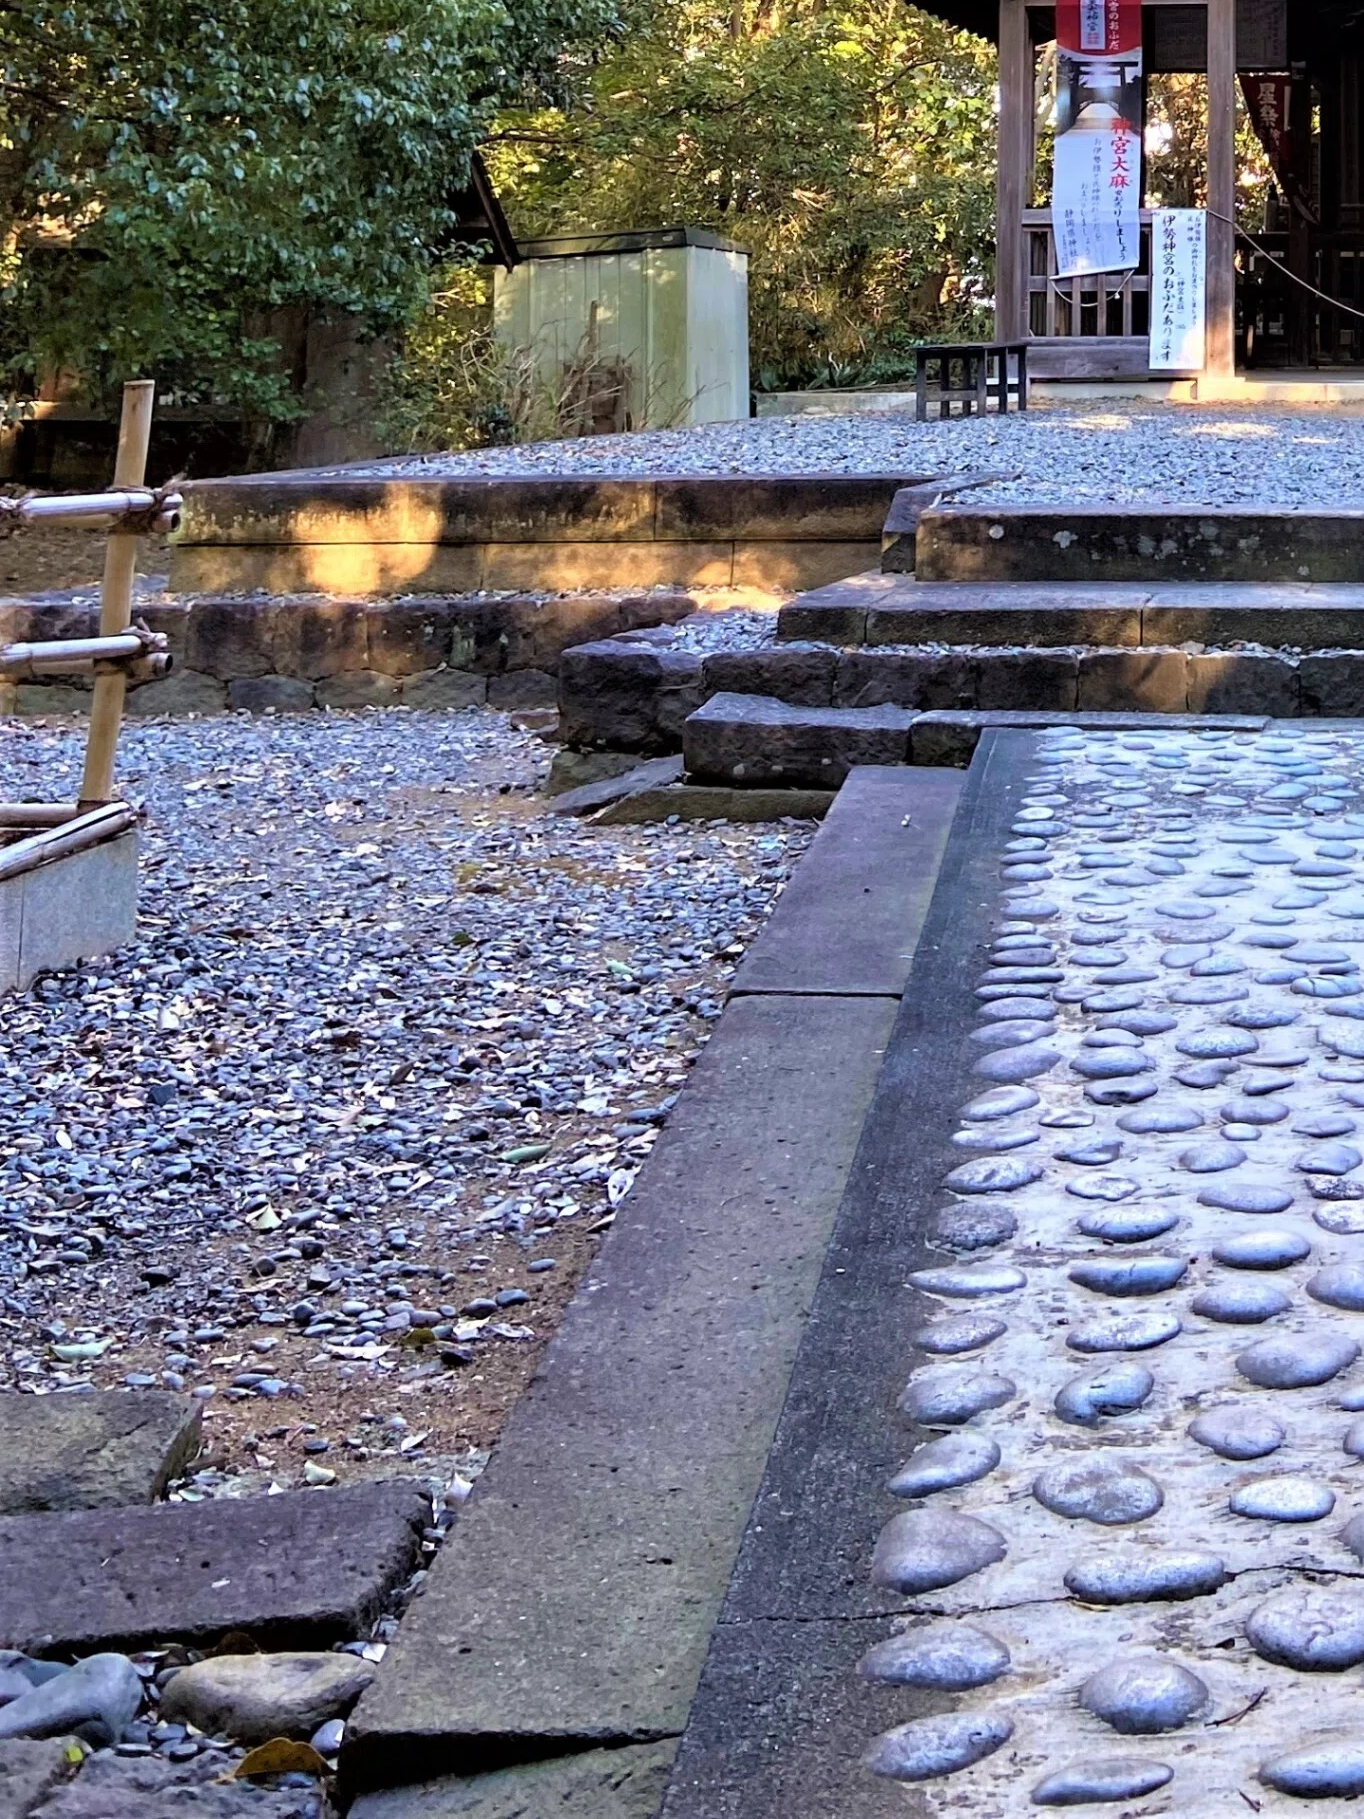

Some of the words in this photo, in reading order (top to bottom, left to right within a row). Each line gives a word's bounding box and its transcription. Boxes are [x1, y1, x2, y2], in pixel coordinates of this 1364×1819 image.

[1160, 214, 1177, 362] 伊勢神宮のおふだあります
